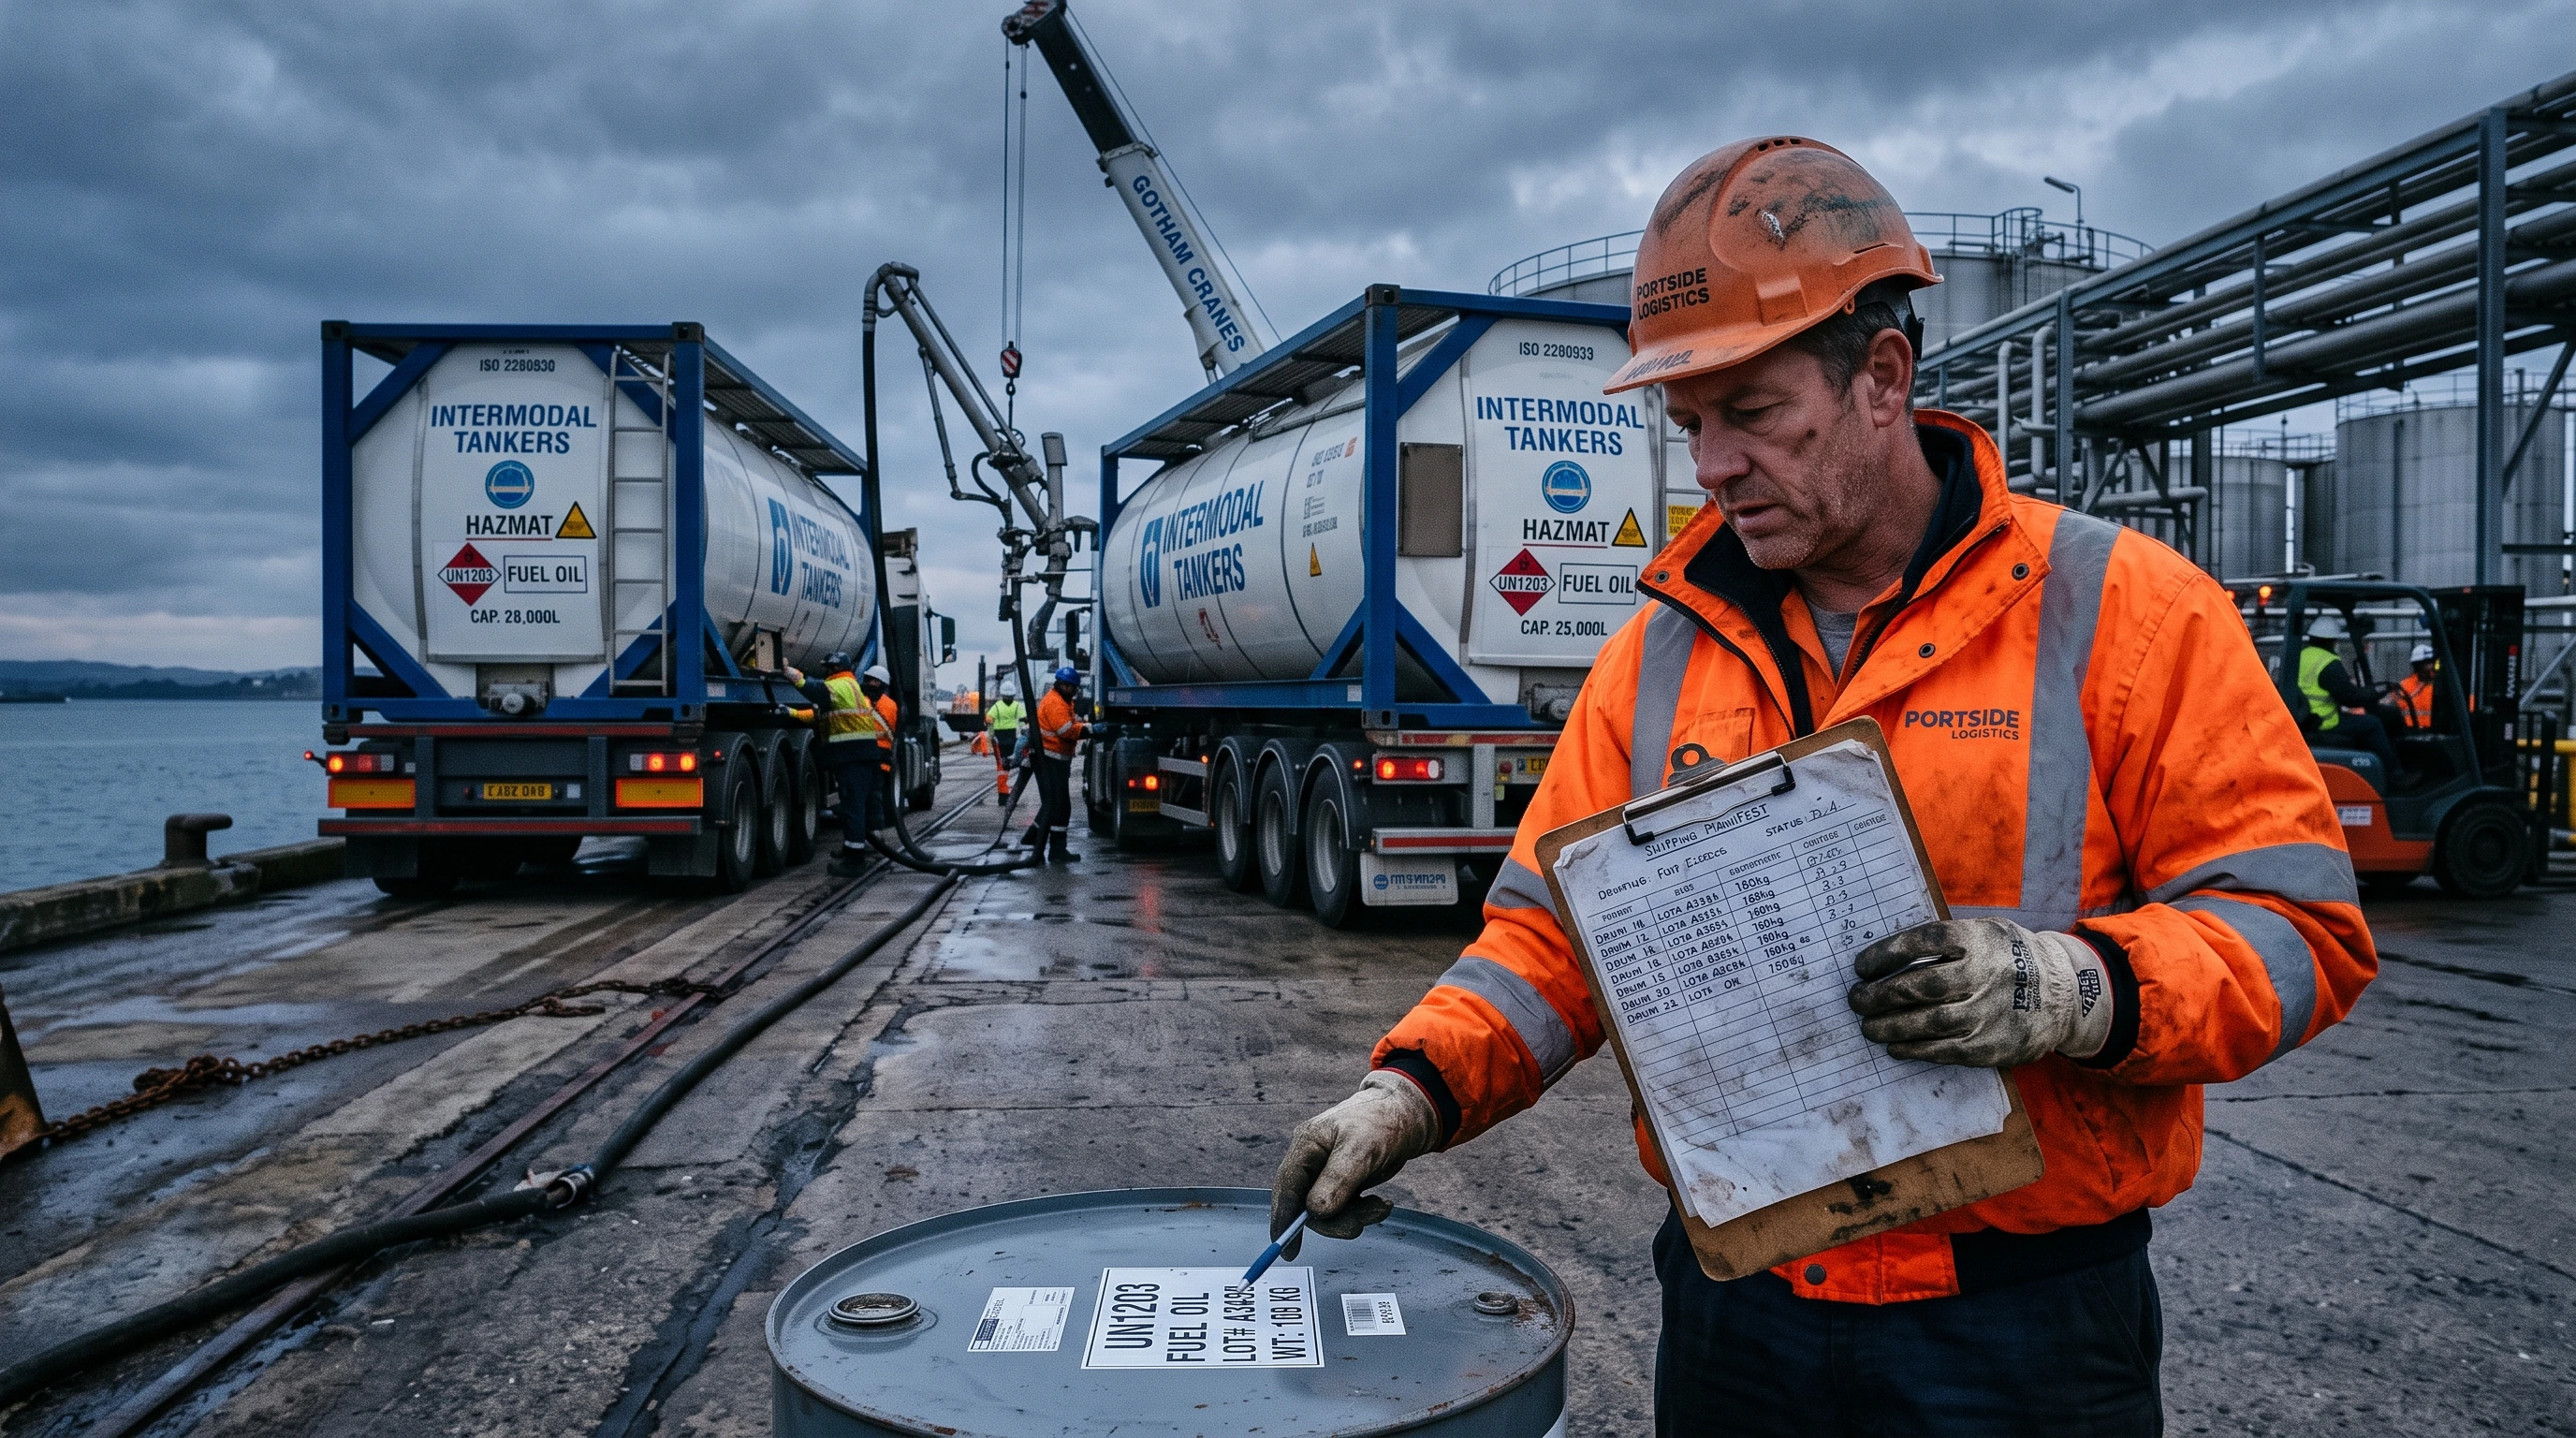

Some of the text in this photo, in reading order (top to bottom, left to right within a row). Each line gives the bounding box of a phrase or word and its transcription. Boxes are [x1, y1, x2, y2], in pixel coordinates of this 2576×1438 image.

[1133, 175, 1246, 353] GOTHAM CRANES
[1636, 268, 1707, 301] PORTSIDE
[1638, 287, 1710, 320] LOGISTICS
[1519, 342, 1594, 360] ISO 2280933
[479, 359, 500, 372] ISO
[431, 404, 597, 428] INTERMODAL
[1476, 396, 1645, 430] INTERMODAL
[454, 431, 570, 454] TANKERS
[1504, 426, 1623, 456] TANKERS
[466, 515, 553, 536] HAZMAT
[1163, 480, 1265, 555] INTERMODAL
[1522, 519, 1610, 543] HAZMAT
[446, 568, 493, 582] UN1203
[507, 565, 583, 582] FUEL OIL
[1174, 542, 1246, 601] TANKERS
[801, 561, 842, 609] TANKERS
[1499, 576, 1548, 592] UN1203
[1562, 574, 1634, 594] FUEL OIL
[470, 609, 561, 625] CAP. 28,000L
[1520, 620, 1608, 638] CAP. 25,000L
[1905, 709, 2020, 729] PORTSIDE
[1952, 728, 2019, 741] LOGISTICS
[1105, 1284, 1161, 1349] UN1203
[1166, 1292, 1209, 1361] FUEL OIL
[1222, 1328, 1256, 1361] LOT#
[1271, 1331, 1307, 1360] WT:
